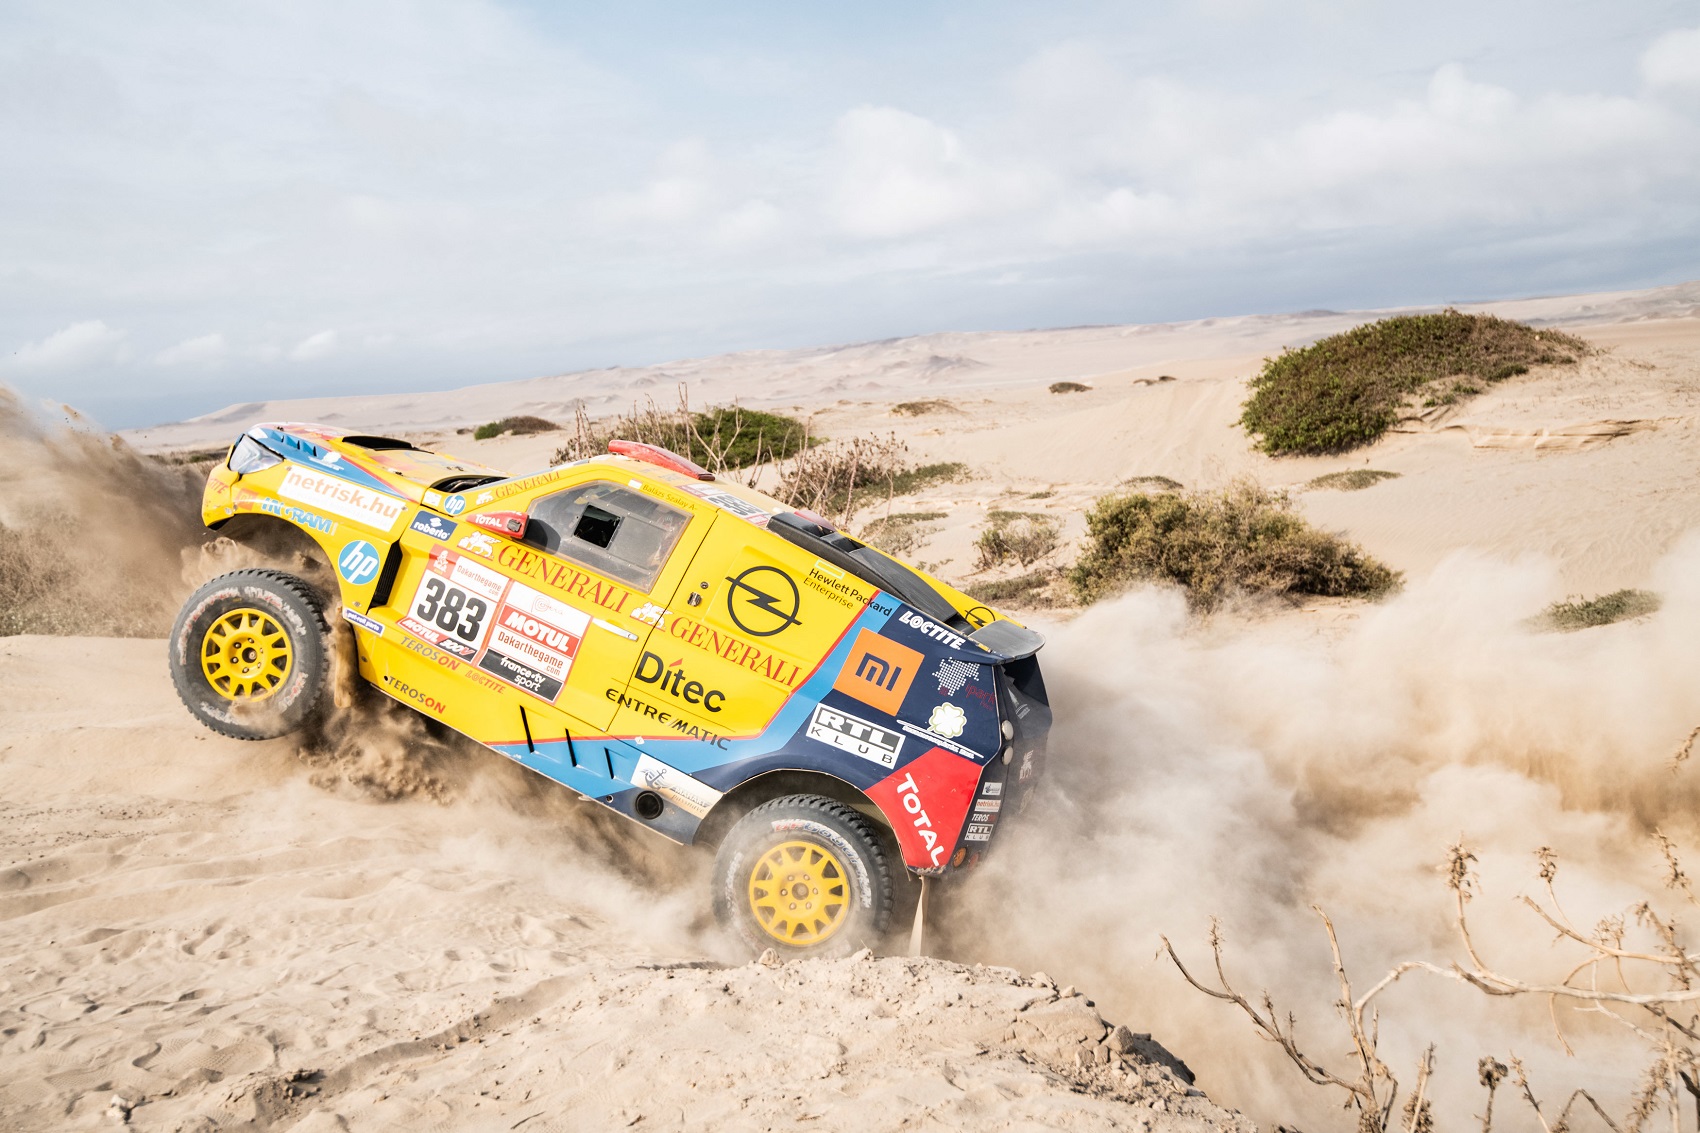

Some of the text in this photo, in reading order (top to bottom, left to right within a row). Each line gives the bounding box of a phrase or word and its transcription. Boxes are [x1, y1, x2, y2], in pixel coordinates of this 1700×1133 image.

[288, 471, 399, 519] netrisk.hu
[495, 472, 560, 499] GENERALI
[642, 484, 665, 498] Balázs
[666, 494, 688, 508] Szalay
[445, 494, 464, 514] hp
[475, 514, 502, 528] TOTAL
[340, 541, 378, 584] hp
[457, 565, 502, 592] Dakarthegame
[498, 544, 632, 614] GENERALI
[416, 577, 487, 642] 383
[803, 577, 854, 610] Enterprise
[809, 568, 893, 617] Hewlett Packard
[402, 620, 440, 643] MOTUL
[440, 639, 476, 656] 300V
[504, 612, 569, 652] MOTUL
[899, 610, 966, 650] LOCTITE
[400, 636, 460, 671] TEROSON
[498, 631, 564, 669] Dakarthegame
[670, 616, 802, 688] GENERALI
[388, 676, 446, 714] TEROSON
[465, 670, 506, 694] LOCTITE
[514, 674, 540, 692] sport
[818, 711, 896, 752] RTL
[896, 772, 946, 868] TOTAL
[969, 826, 990, 834] RTL
